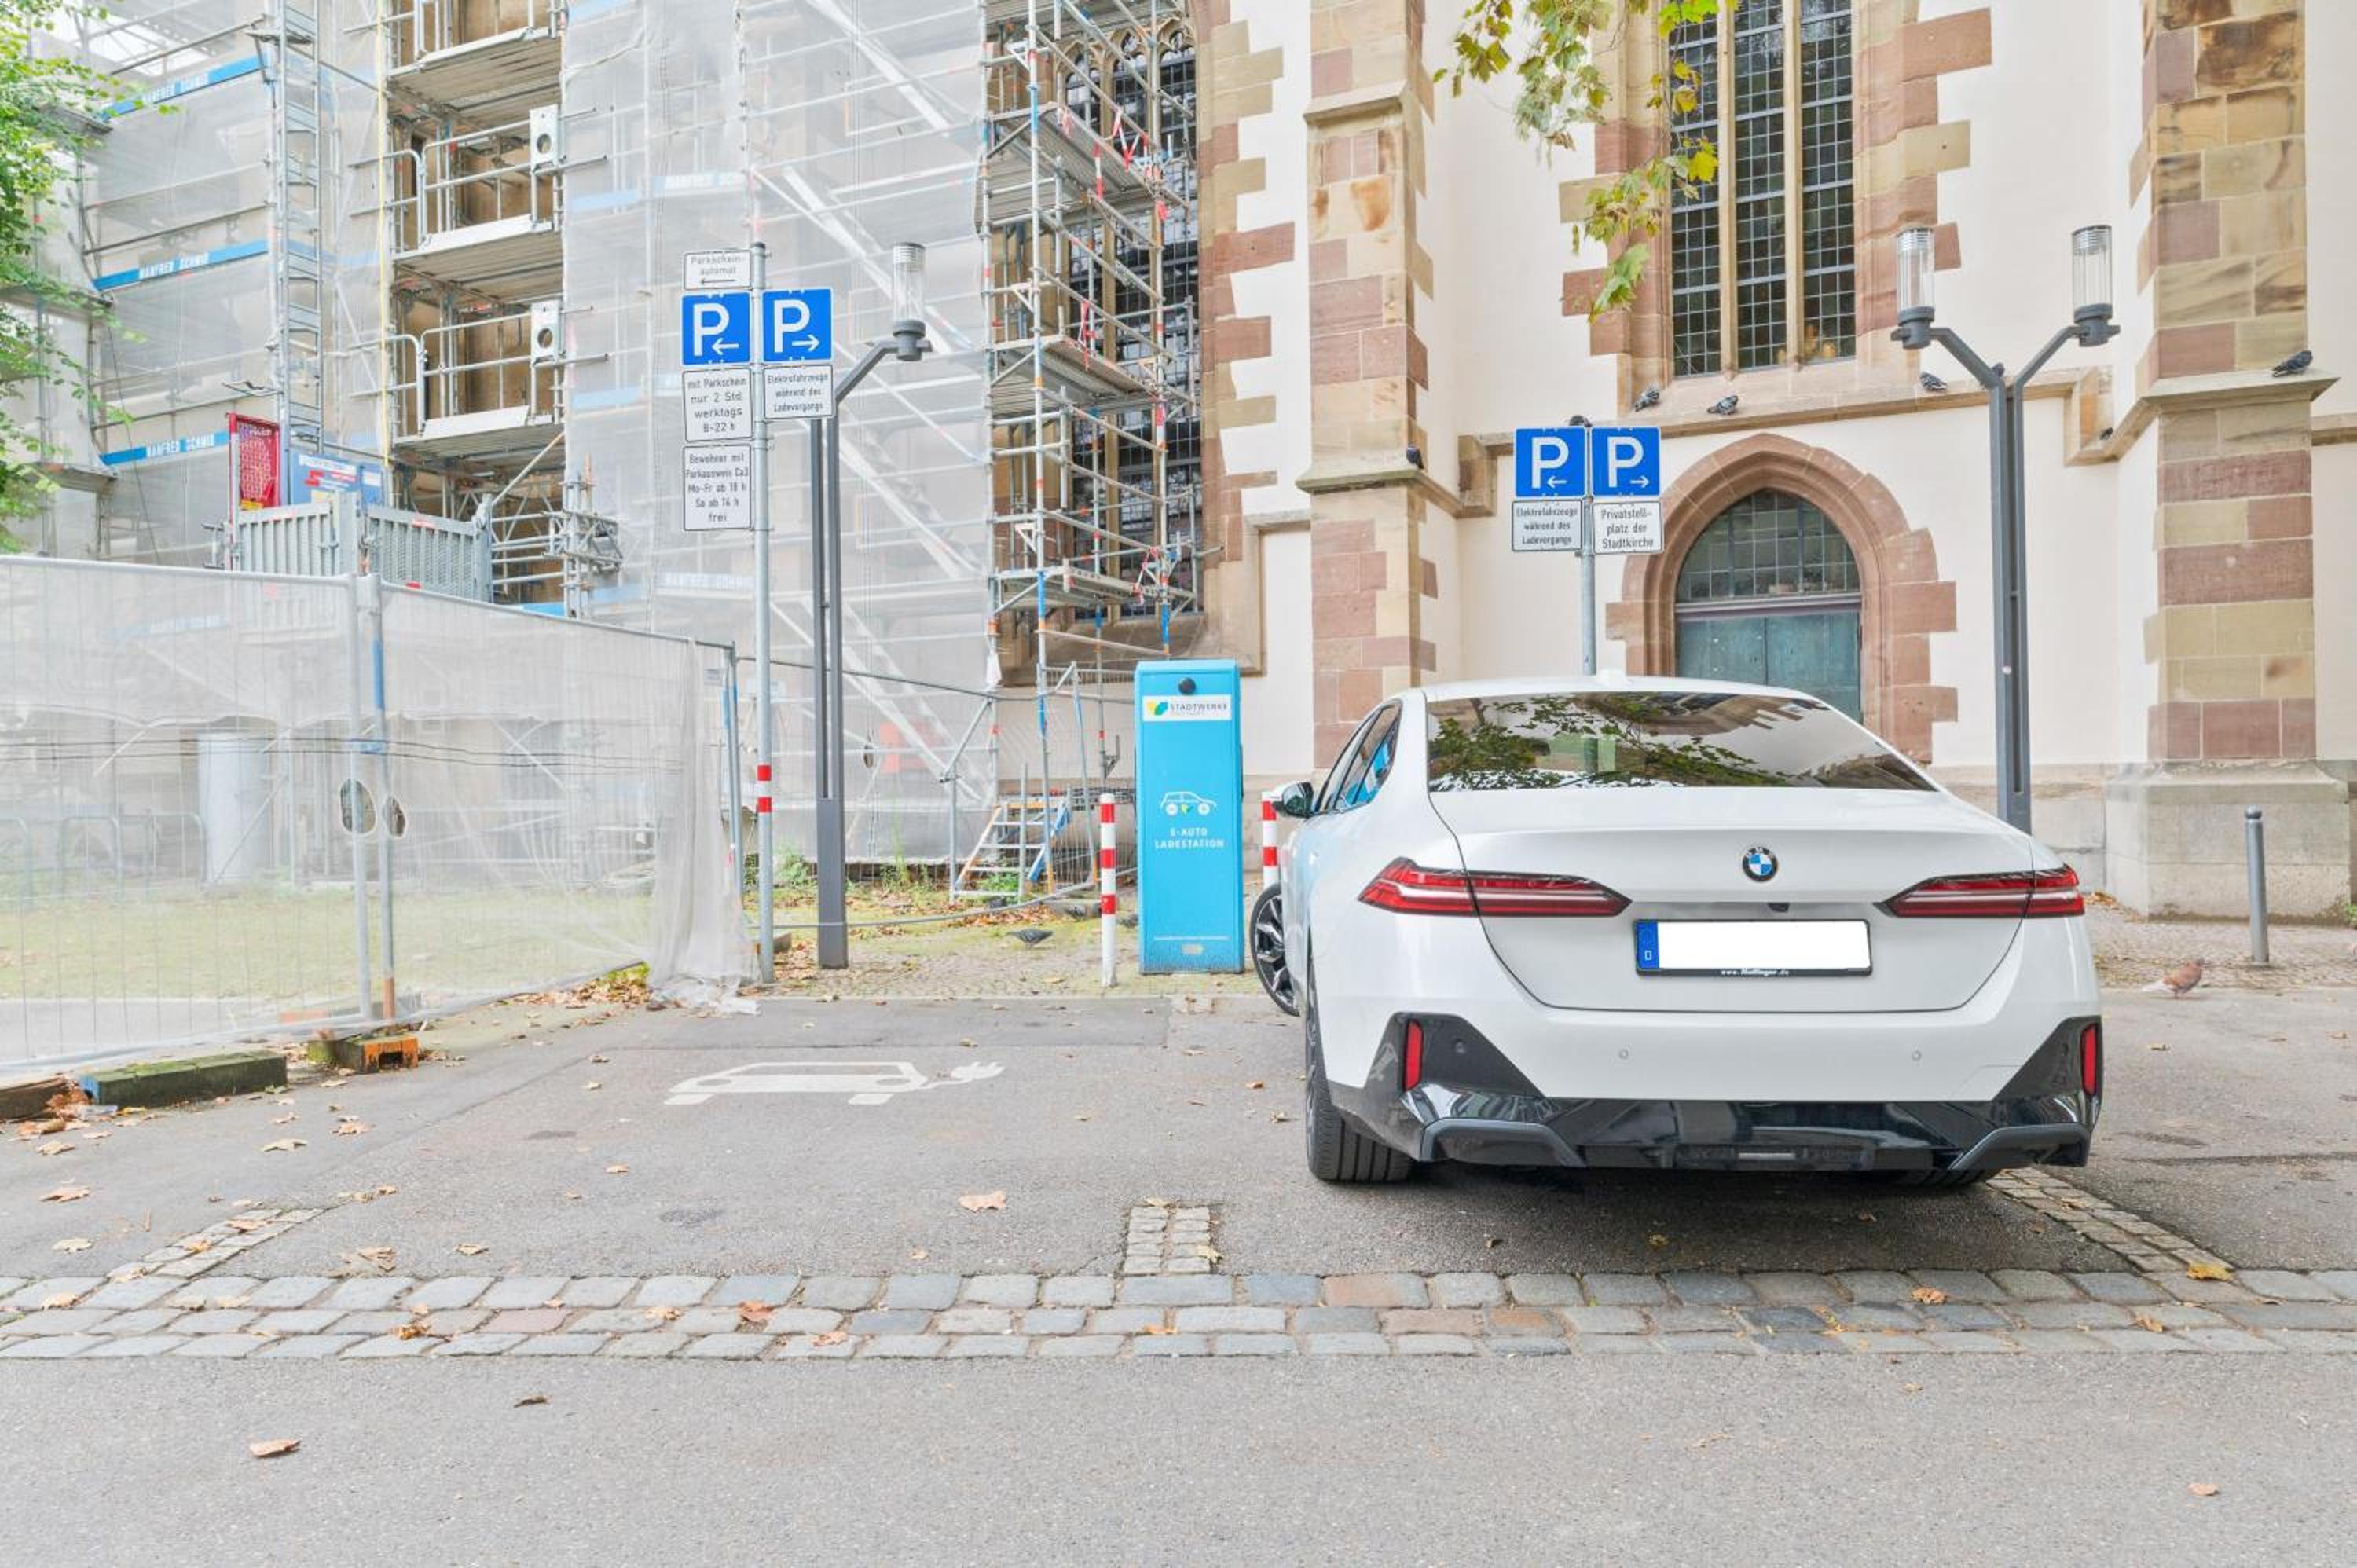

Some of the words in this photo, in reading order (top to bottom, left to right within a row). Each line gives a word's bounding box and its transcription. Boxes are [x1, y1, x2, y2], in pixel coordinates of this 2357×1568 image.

[693, 302, 730, 357] P
[774, 299, 810, 353] P
[687, 379, 702, 390] mit
[704, 376, 746, 388] Parkschein
[768, 374, 829, 384] Elektrofahrzeuge
[808, 387, 821, 396] des
[691, 394, 708, 403] nur
[714, 392, 721, 402] 2
[774, 402, 823, 412] Ladevorgangs
[694, 407, 742, 419] werktags
[690, 453, 727, 463] Bewohner
[731, 452, 743, 462] mit
[1532, 436, 1569, 489] P
[1607, 436, 1644, 488] P
[716, 483, 726, 493] ab
[741, 482, 746, 491] h
[695, 497, 706, 508] Sa
[709, 497, 719, 507] ab
[734, 496, 739, 507] h
[709, 512, 727, 522] frei
[1516, 507, 1578, 518] Elektrofahrzeuge
[1601, 507, 1652, 520] Privatstell-
[1523, 522, 1556, 530] während
[1558, 519, 1571, 529] des
[1607, 523, 1629, 536] platz
[1633, 523, 1648, 533] der
[1522, 536, 1572, 546] Ladevorgangs
[1602, 536, 1654, 549] Stadtkirche
[1170, 702, 1228, 712] STADTWERKE
[1170, 827, 1208, 837] E-AUTO
[1154, 838, 1225, 849] LADESTATION
[1644, 950, 1652, 961] D
